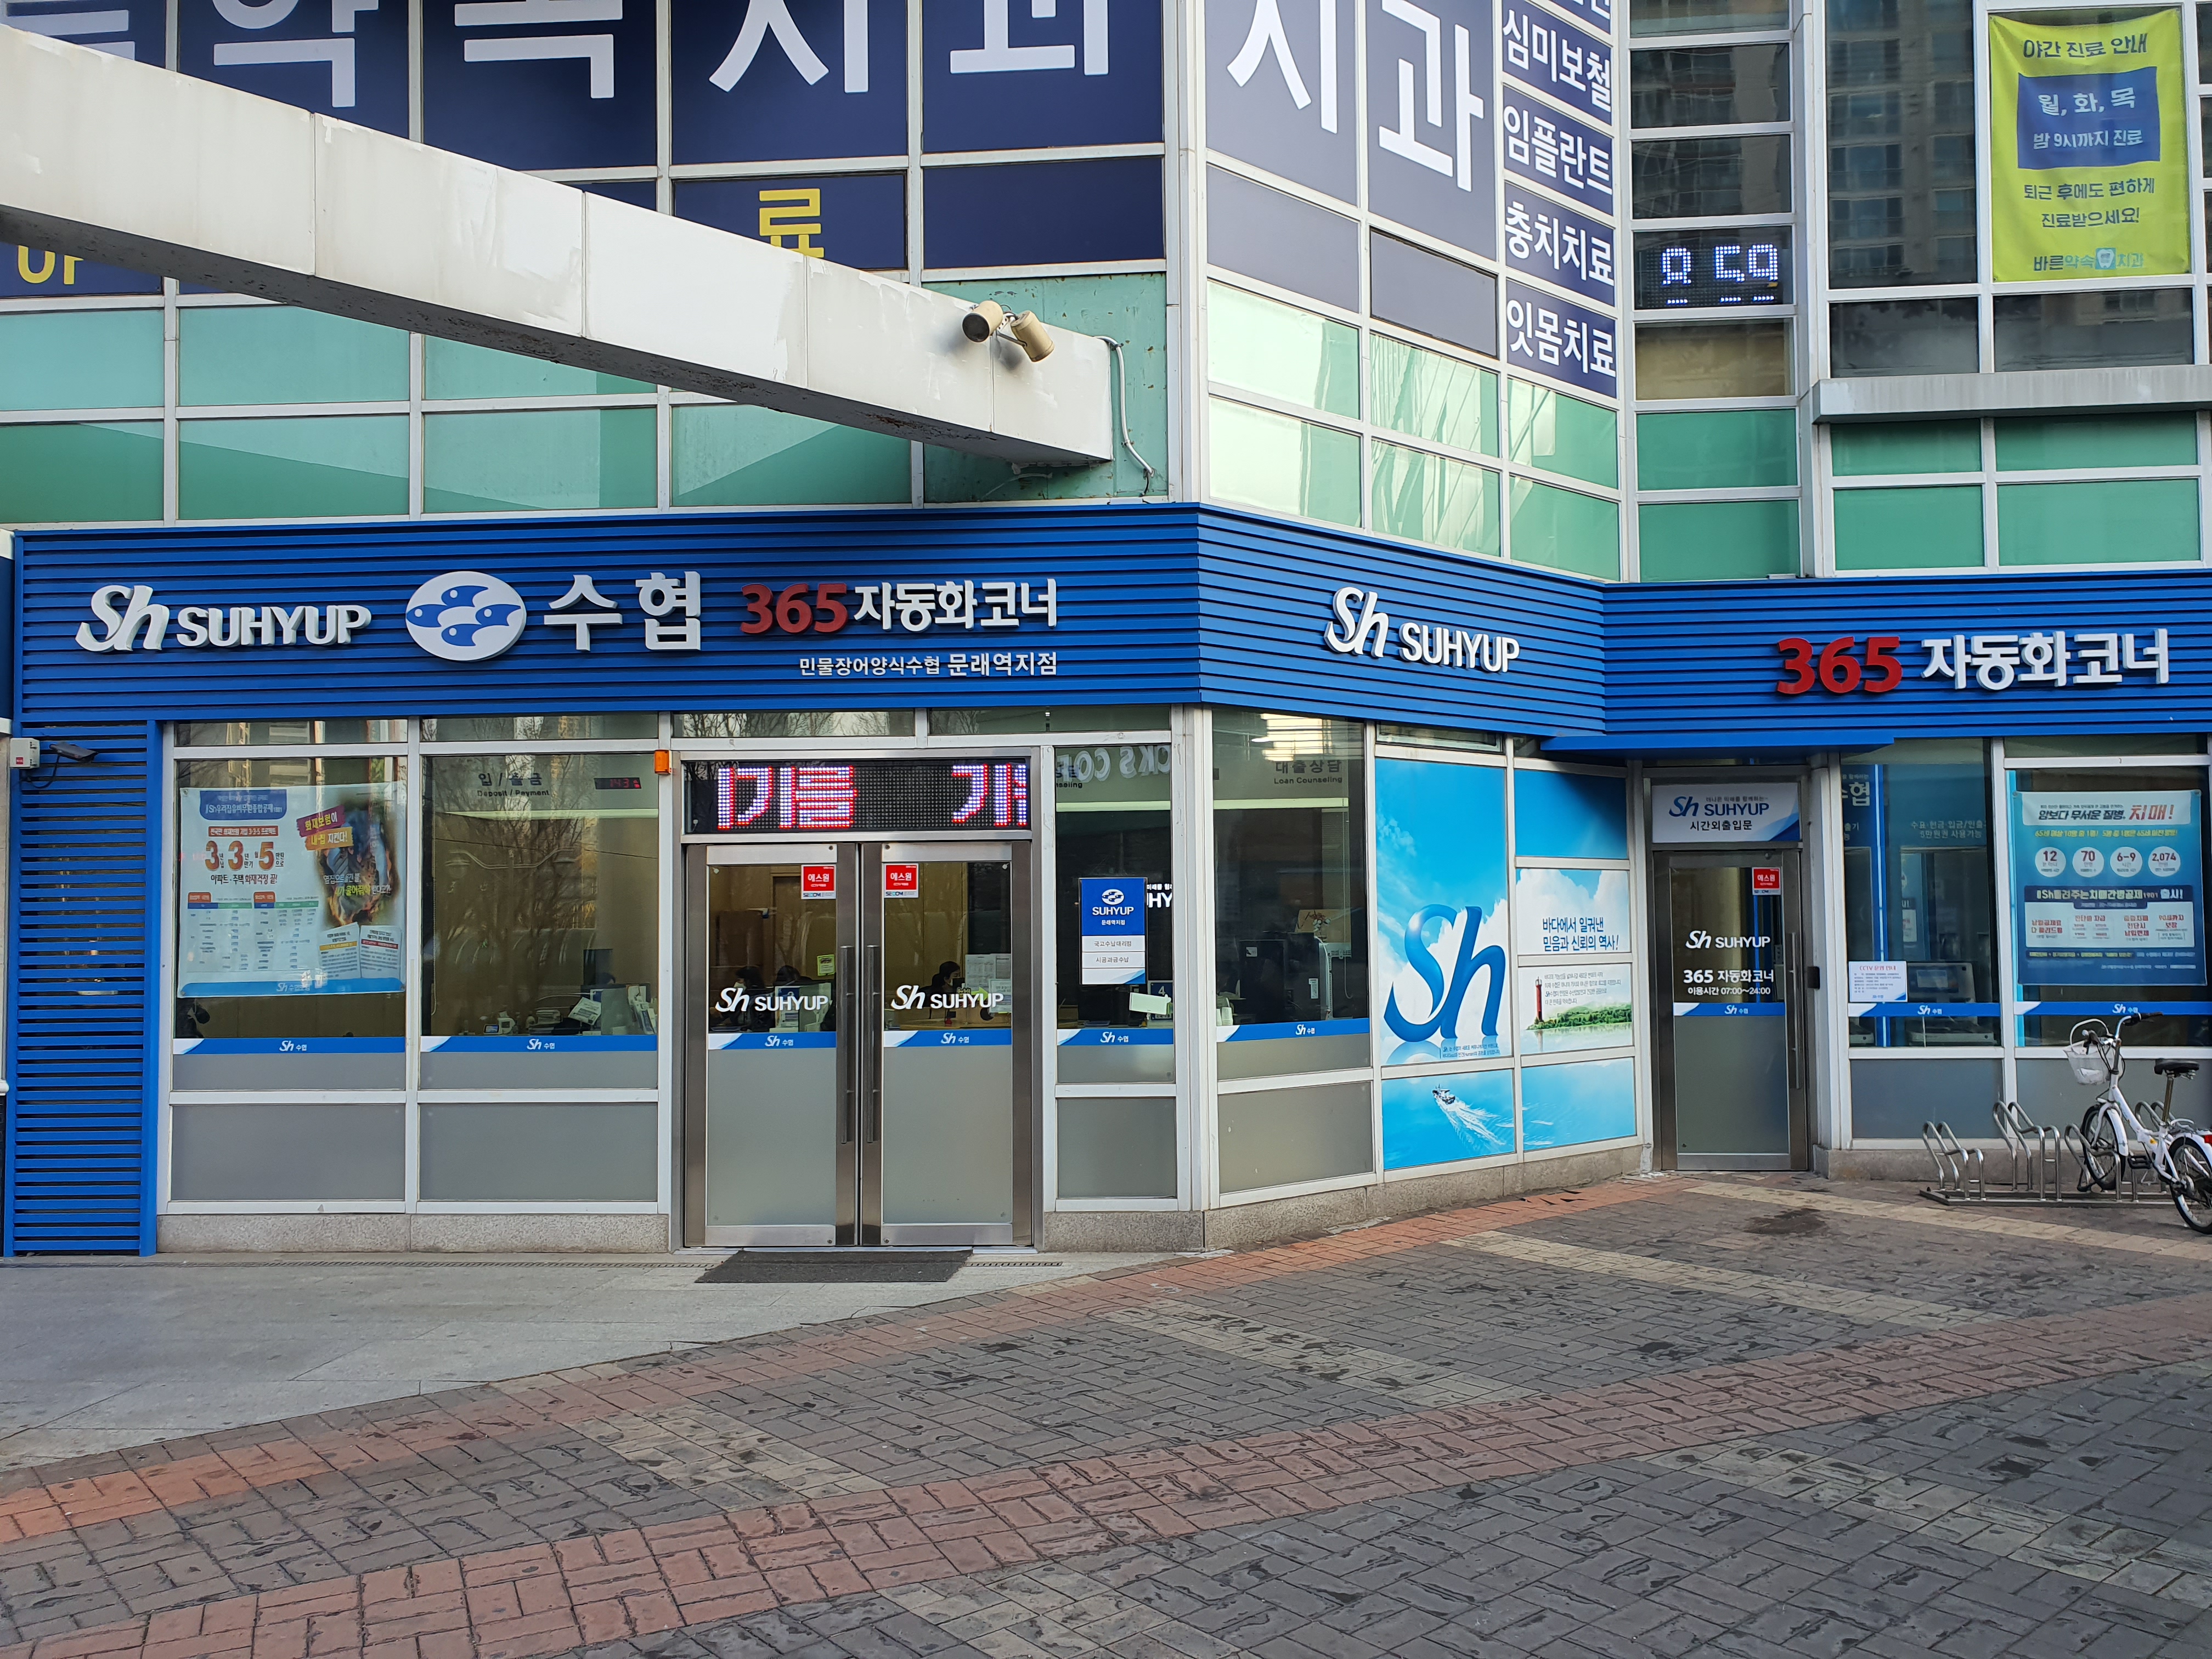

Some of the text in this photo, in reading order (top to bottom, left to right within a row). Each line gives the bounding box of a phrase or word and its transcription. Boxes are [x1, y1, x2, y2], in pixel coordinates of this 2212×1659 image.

[2023, 33, 2147, 58] 야간 진료 안내
[1503, 9, 1612, 112] 심미보철
[2038, 87, 2136, 116] 월, 화, 목
[2033, 129, 2144, 149] 밤 9시까지 진료
[1504, 106, 1612, 195] 임플란트
[2024, 177, 2154, 200] 퇴근 후에도 편하게
[2041, 207, 2140, 228] 진료받으세요!
[1505, 201, 1614, 286] 충치치료
[1506, 300, 1616, 377] 잇몸치료
[544, 571, 701, 651] 수협
[740, 578, 1058, 635] 365 자동화코너
[75, 585, 372, 652] Sh SUHYUP
[1323, 586, 1520, 673] Sh SUHYUP
[799, 652, 1057, 676] 민물장어양식수협 문래역지점
[1776, 636, 1903, 695] 365
[1669, 796, 1769, 817] Sh SUHYUP
[2039, 810, 2069, 821] 암보다
[2071, 810, 2102, 821] 무서운
[1690, 820, 1753, 831] 시간외출입문
[328, 831, 347, 843] 지킨다!
[205, 840, 219, 871] 3
[228, 840, 243, 871] 3
[259, 842, 274, 870] 5
[2043, 851, 2057, 861] 12
[2081, 851, 2095, 861] 70
[211, 874, 229, 884] 아파트
[245, 874, 268, 884] 화재걱정
[808, 873, 830, 882] 에스원
[890, 872, 912, 881] 에스원
[1092, 906, 1135, 916] SUHYUP
[1542, 916, 1604, 933] 바다에서 일궈낸
[1543, 934, 1619, 952] 믿음과 신뢰의 역사!
[1685, 930, 1771, 949] Sh SUHYUP
[1383, 903, 1506, 1043] Sh
[1683, 969, 1713, 984] 365
[715, 988, 829, 1013] Sh SUHYUP
[890, 985, 1004, 1010] Sh SUHYUP
[1688, 987, 1771, 996] 이용시간 07:00~24:00
[1724, 1005, 1737, 1014] Sh
[1917, 1005, 1931, 1015] Sh
[2112, 1003, 2126, 1014] Sh
[941, 1032, 956, 1044] Sh
[1100, 1032, 1115, 1043] Sh
[1295, 1024, 1306, 1035] Sh
[279, 1040, 307, 1052] Sh 수협
[527, 1039, 543, 1050] Sh
[765, 1035, 780, 1047] Sh
